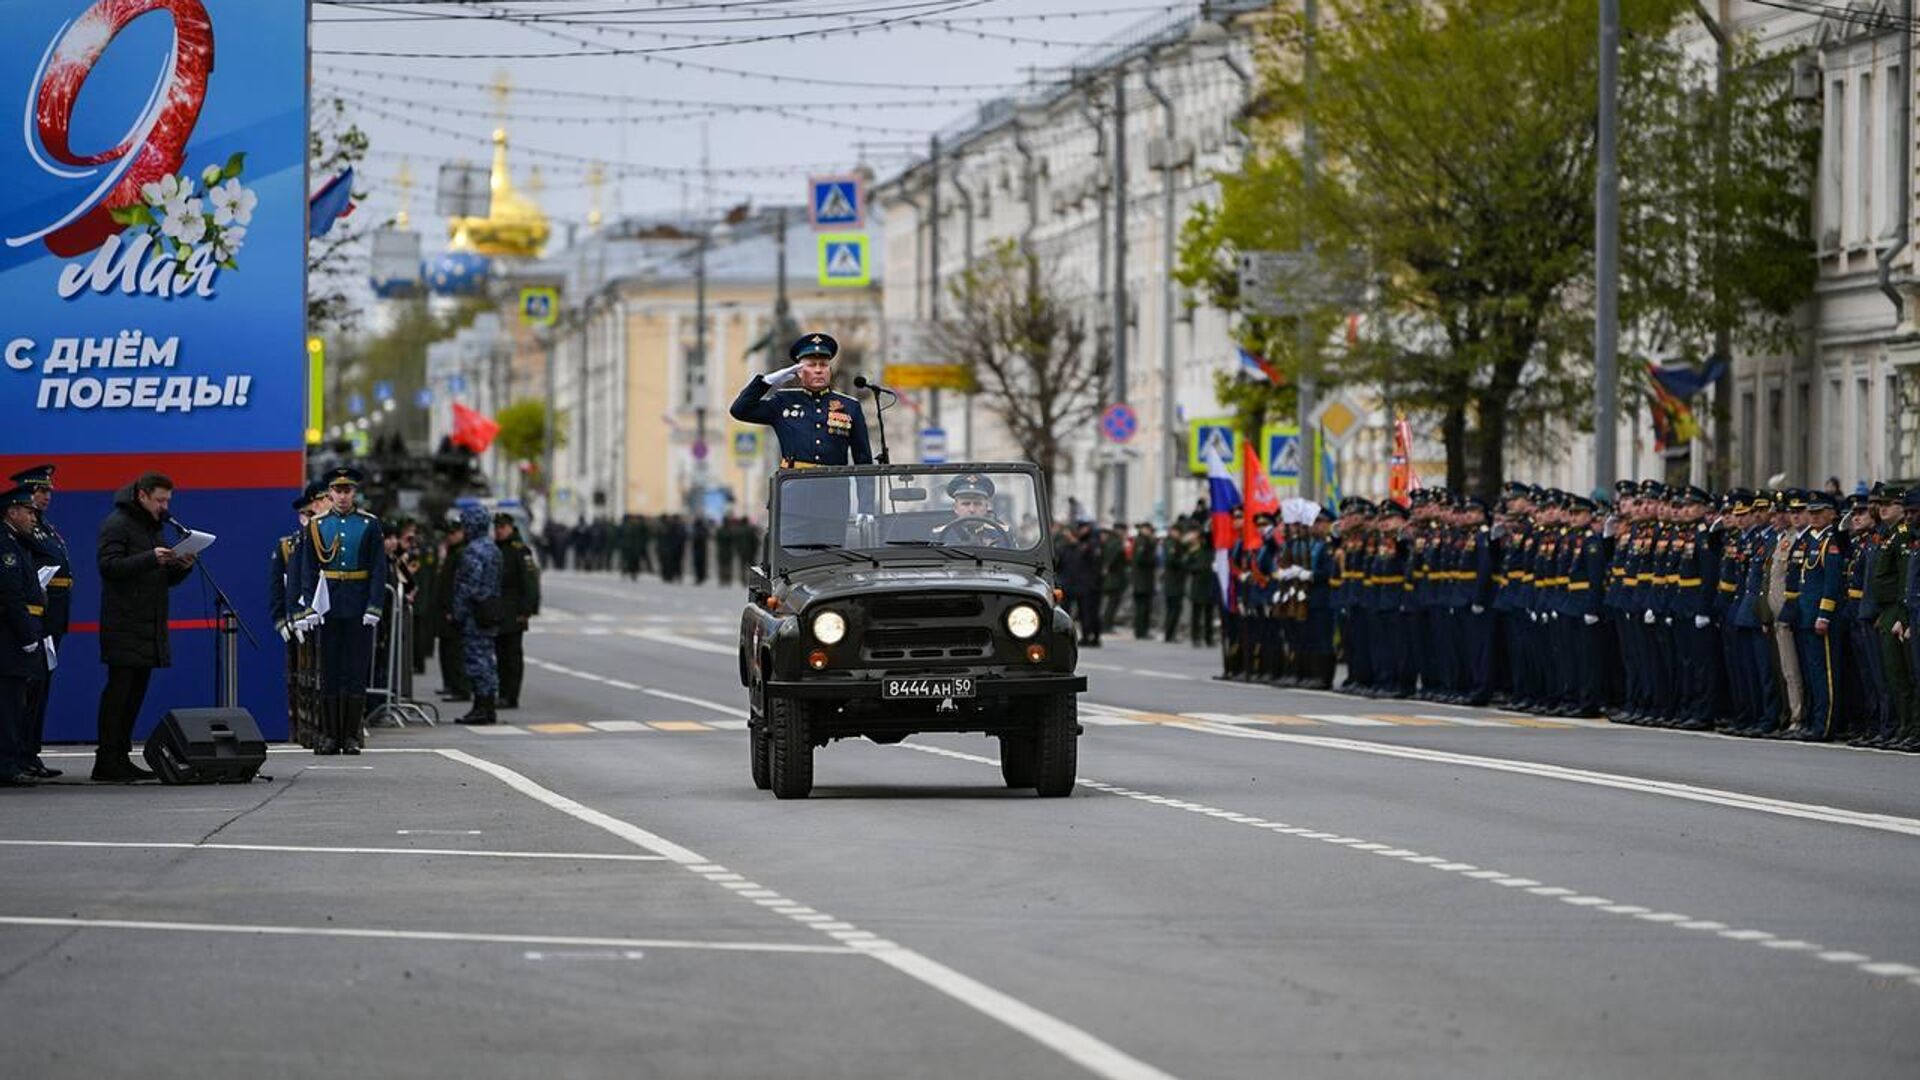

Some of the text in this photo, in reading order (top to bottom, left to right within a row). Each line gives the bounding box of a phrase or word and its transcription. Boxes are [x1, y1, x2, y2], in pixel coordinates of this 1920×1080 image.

[24, 0, 214, 257] 9
[58, 234, 216, 298] Мая
[5, 331, 178, 373] С ДНЁМ
[37, 376, 250, 411] ПОБЕДЫ!
[955, 680, 971, 691] 50
